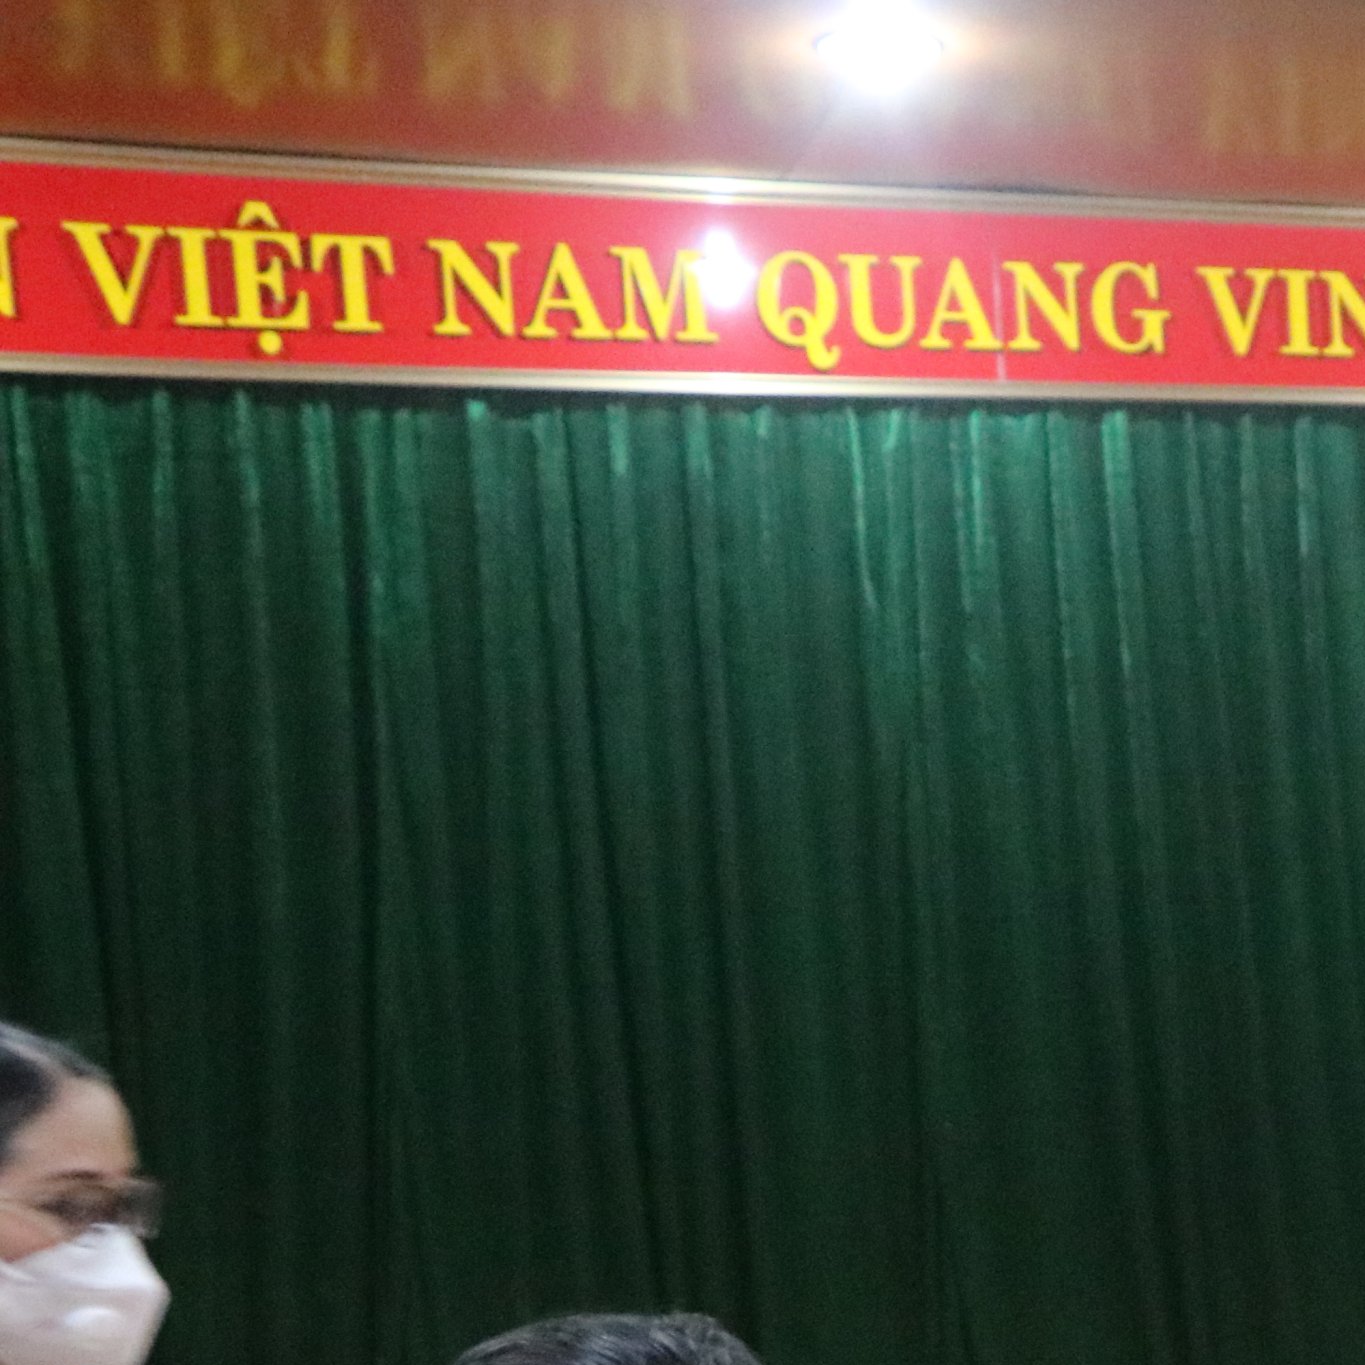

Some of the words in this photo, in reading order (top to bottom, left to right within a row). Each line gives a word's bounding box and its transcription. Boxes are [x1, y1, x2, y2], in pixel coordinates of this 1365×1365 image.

[61, 200, 395, 355] VIỆT
[427, 238, 720, 343] NAM
[756, 250, 1172, 371] QUANG
